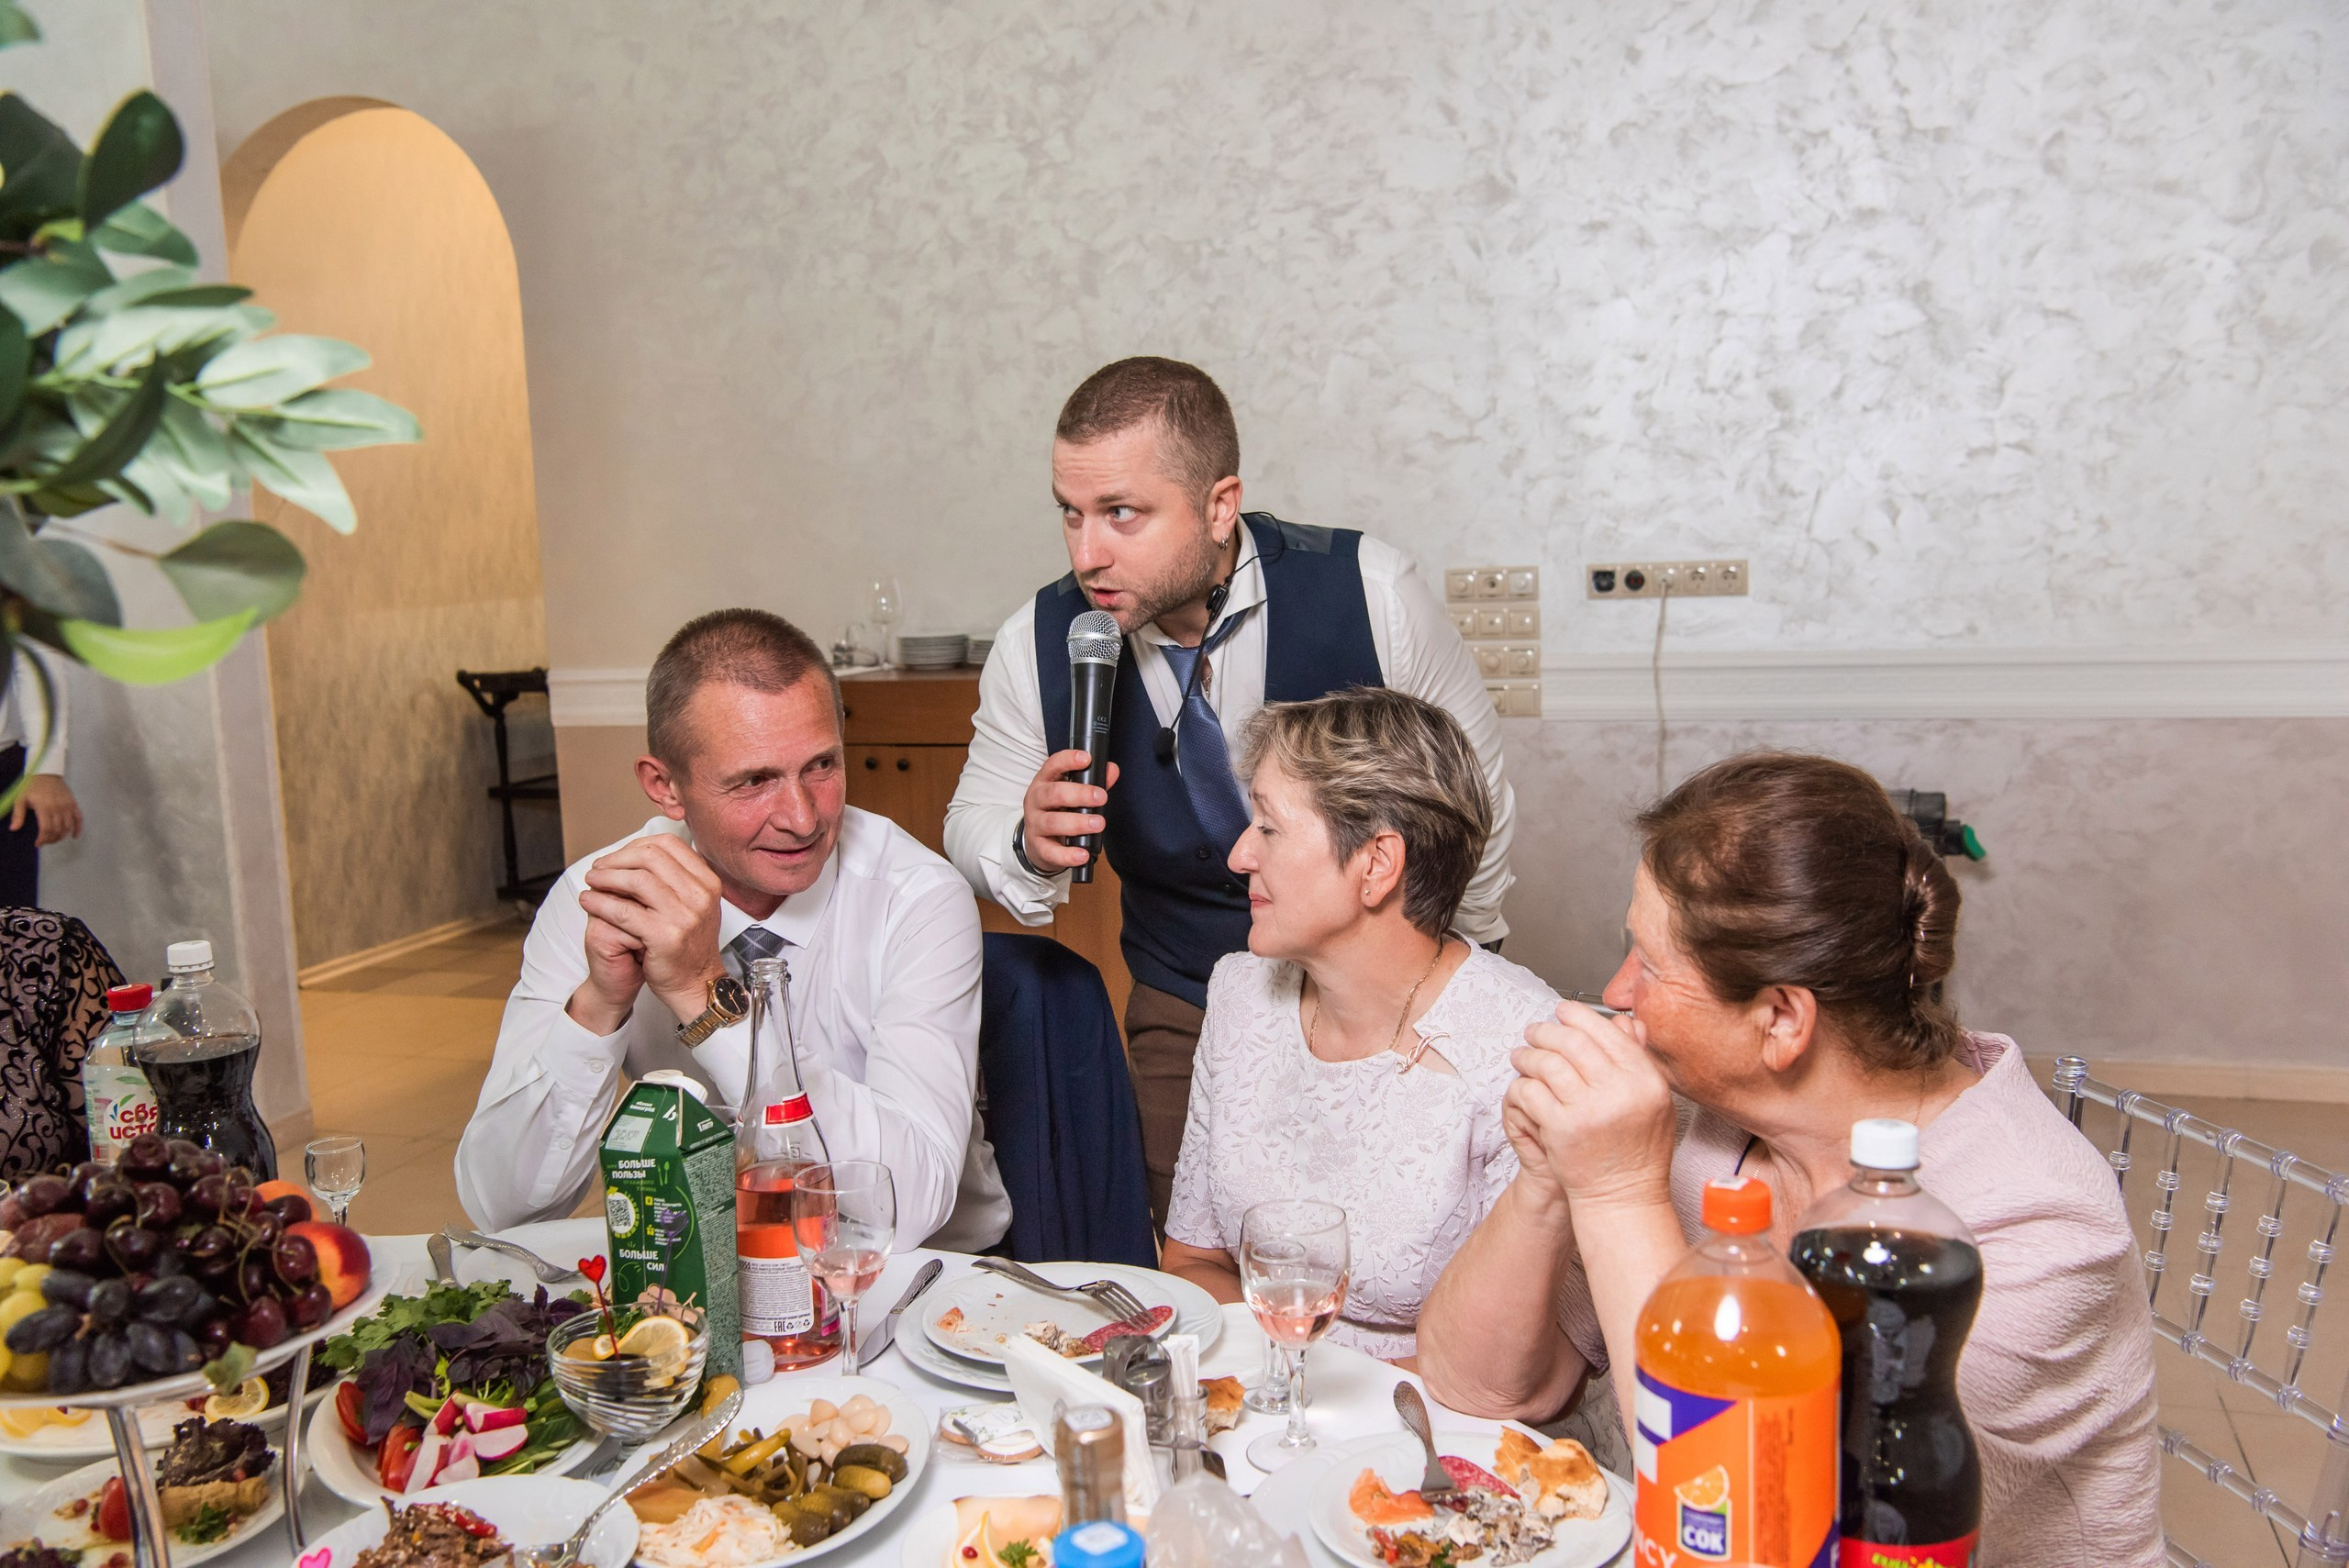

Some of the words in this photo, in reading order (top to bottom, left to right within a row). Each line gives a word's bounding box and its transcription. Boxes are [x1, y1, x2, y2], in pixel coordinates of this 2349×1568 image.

[618, 1158, 657, 1170] БОЛЬШЕ
[611, 1170, 647, 1180] ПОЛЬЗЫ
[618, 1248, 659, 1261] БОЛЬШЕ
[646, 1262, 665, 1272] СИЛ
